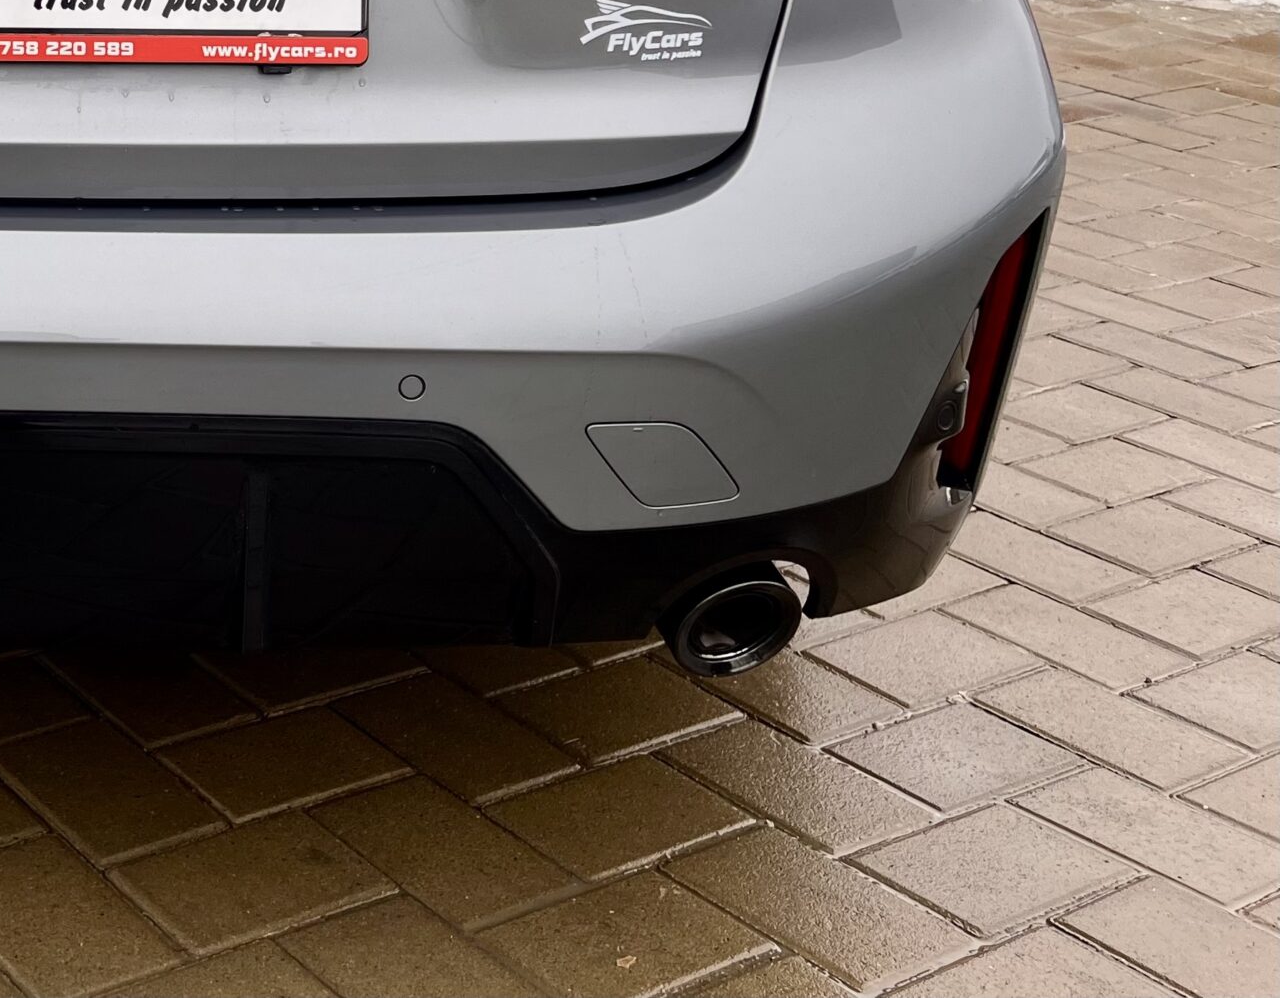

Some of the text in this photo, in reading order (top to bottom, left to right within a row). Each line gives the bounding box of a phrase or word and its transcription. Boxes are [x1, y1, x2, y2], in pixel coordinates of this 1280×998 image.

[45, 41, 87, 56] 220
[93, 41, 134, 56] 589
[201, 42, 358, 62] www.flycars.ro
[607, 31, 703, 56] FlyCars
